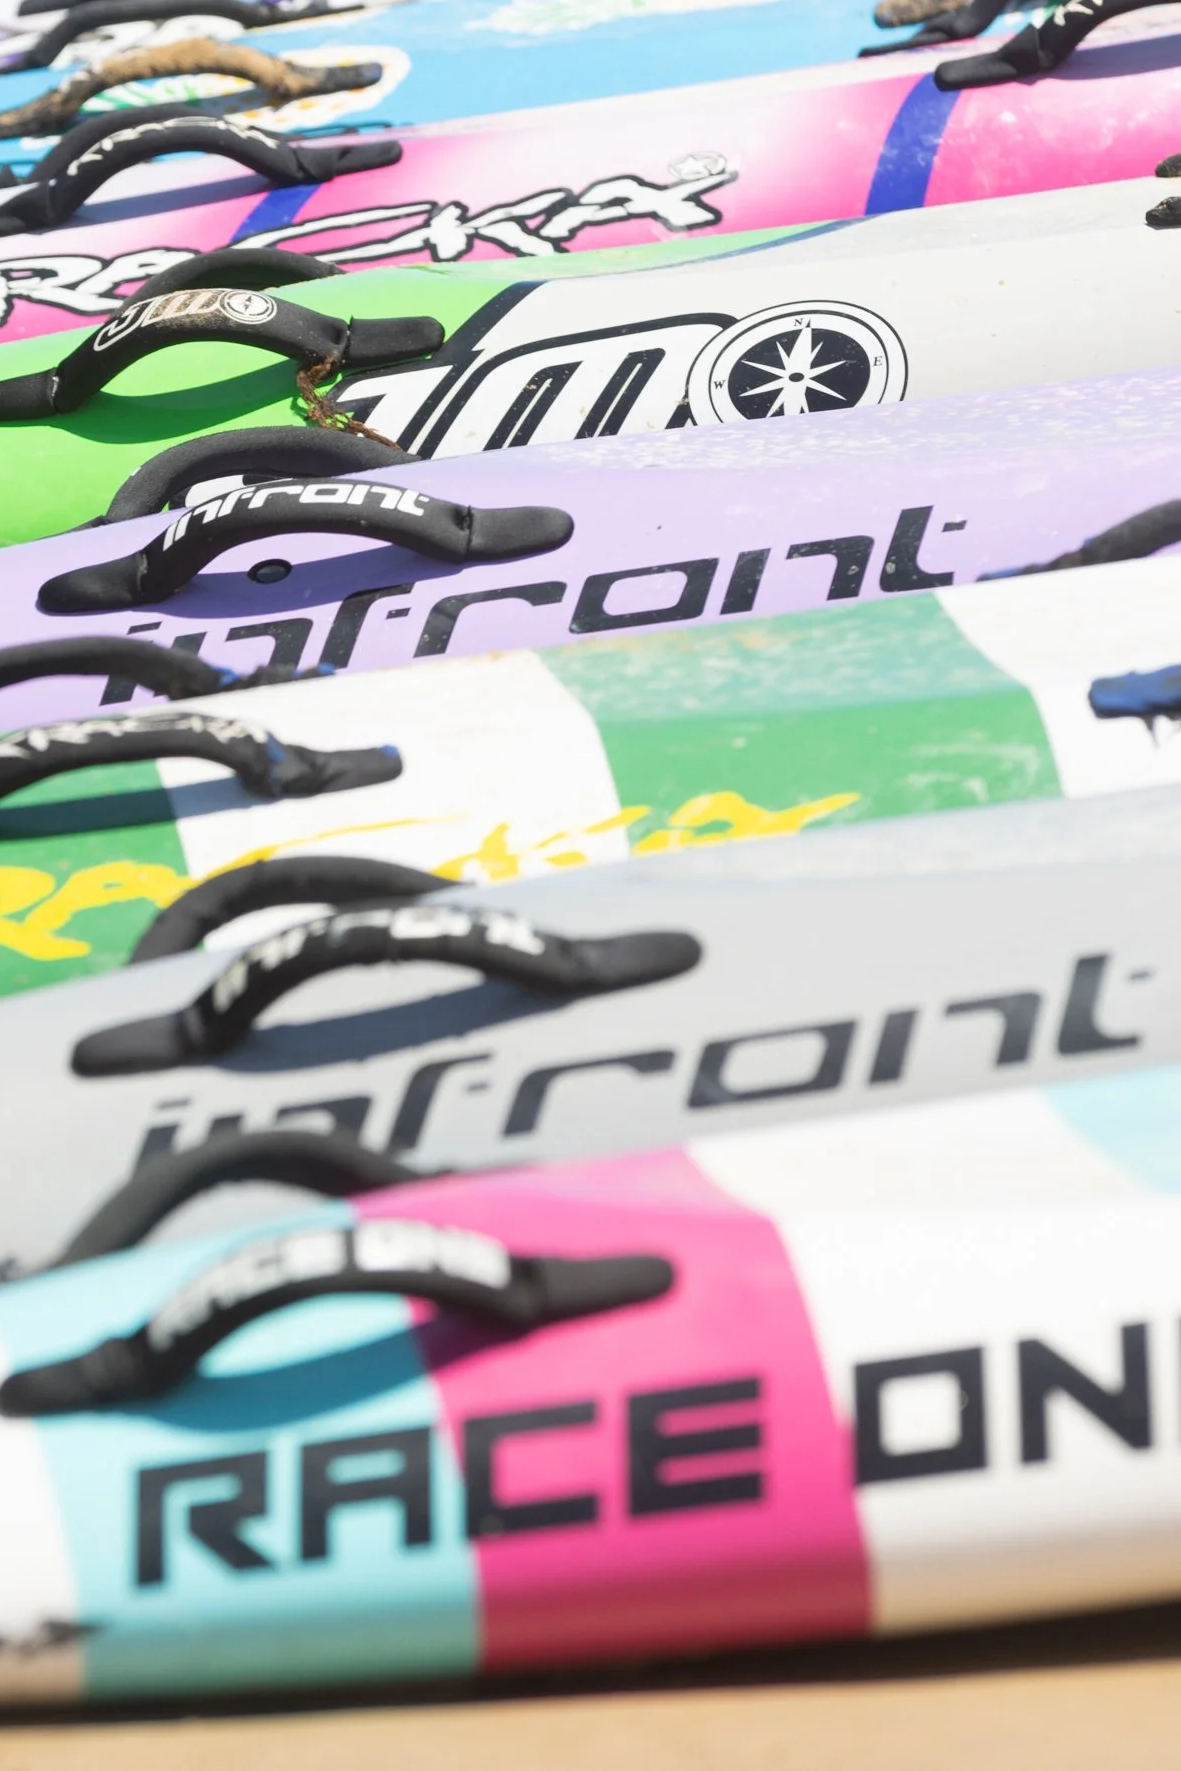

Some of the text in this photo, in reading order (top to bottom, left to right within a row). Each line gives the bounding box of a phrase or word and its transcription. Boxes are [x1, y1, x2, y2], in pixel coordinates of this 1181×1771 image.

[163, 484, 430, 551] infront
[133, 1313, 1181, 1592] RACE ON
